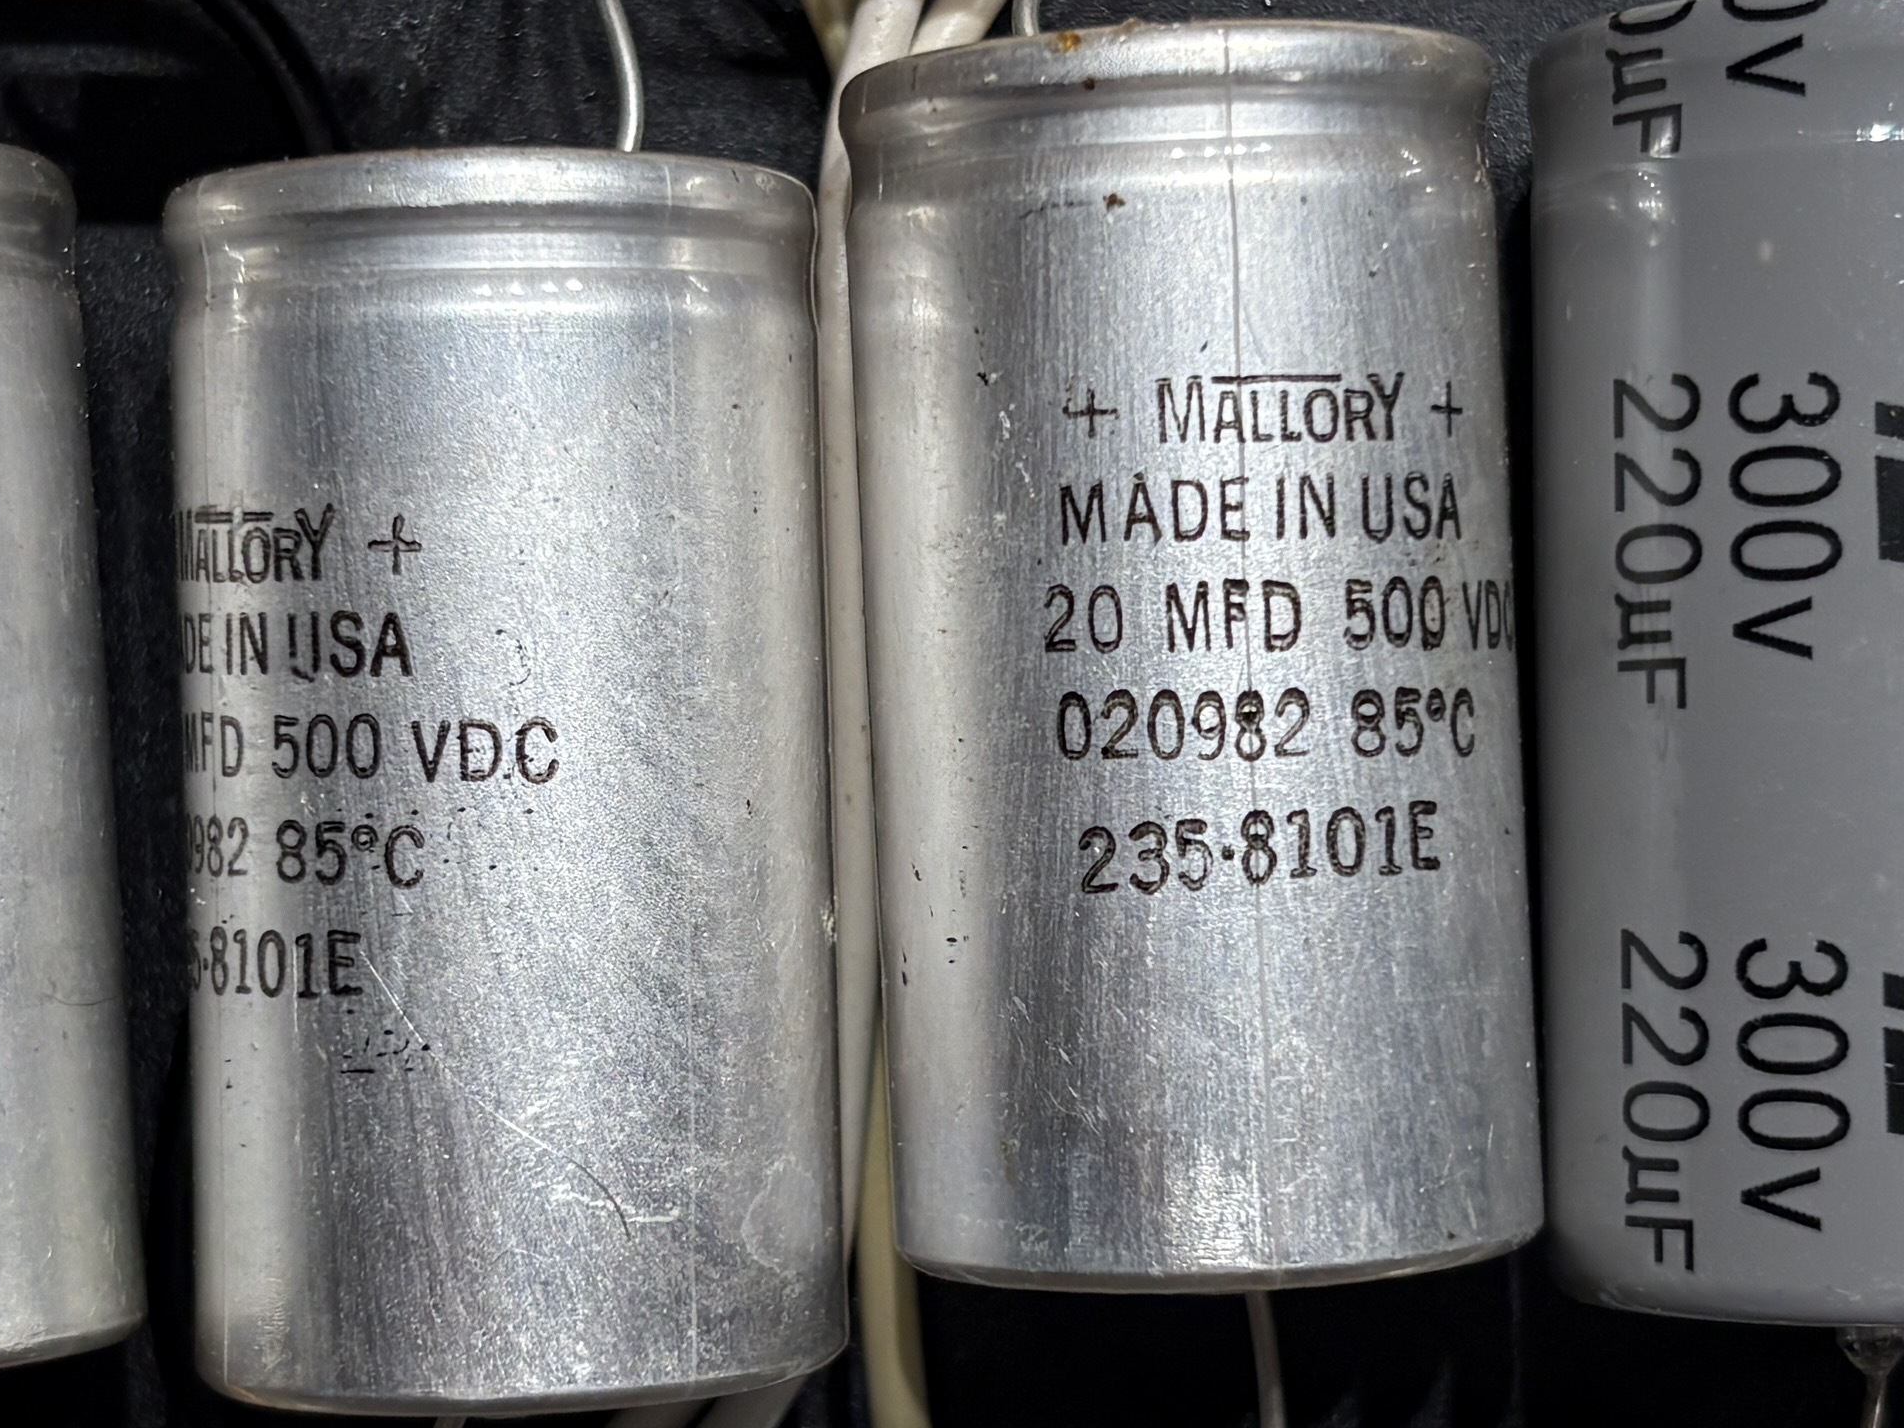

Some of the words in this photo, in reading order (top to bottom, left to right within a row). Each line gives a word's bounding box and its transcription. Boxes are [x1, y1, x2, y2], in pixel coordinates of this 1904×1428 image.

[1156, 372, 1405, 445] MALLORY
[1059, 472, 1251, 545] MADE
[1277, 472, 1338, 540] IN
[1362, 471, 1463, 544] USA
[226, 612, 268, 675] IN
[287, 610, 413, 683] USA
[1043, 584, 1124, 653] 20
[1165, 579, 1303, 653] MFD
[1343, 575, 1447, 651] 500
[271, 713, 382, 780] 500
[411, 715, 559, 785] VDC
[1056, 687, 1312, 762] 020982
[1350, 687, 1477, 759] 85°C
[276, 819, 425, 890] 85°C
